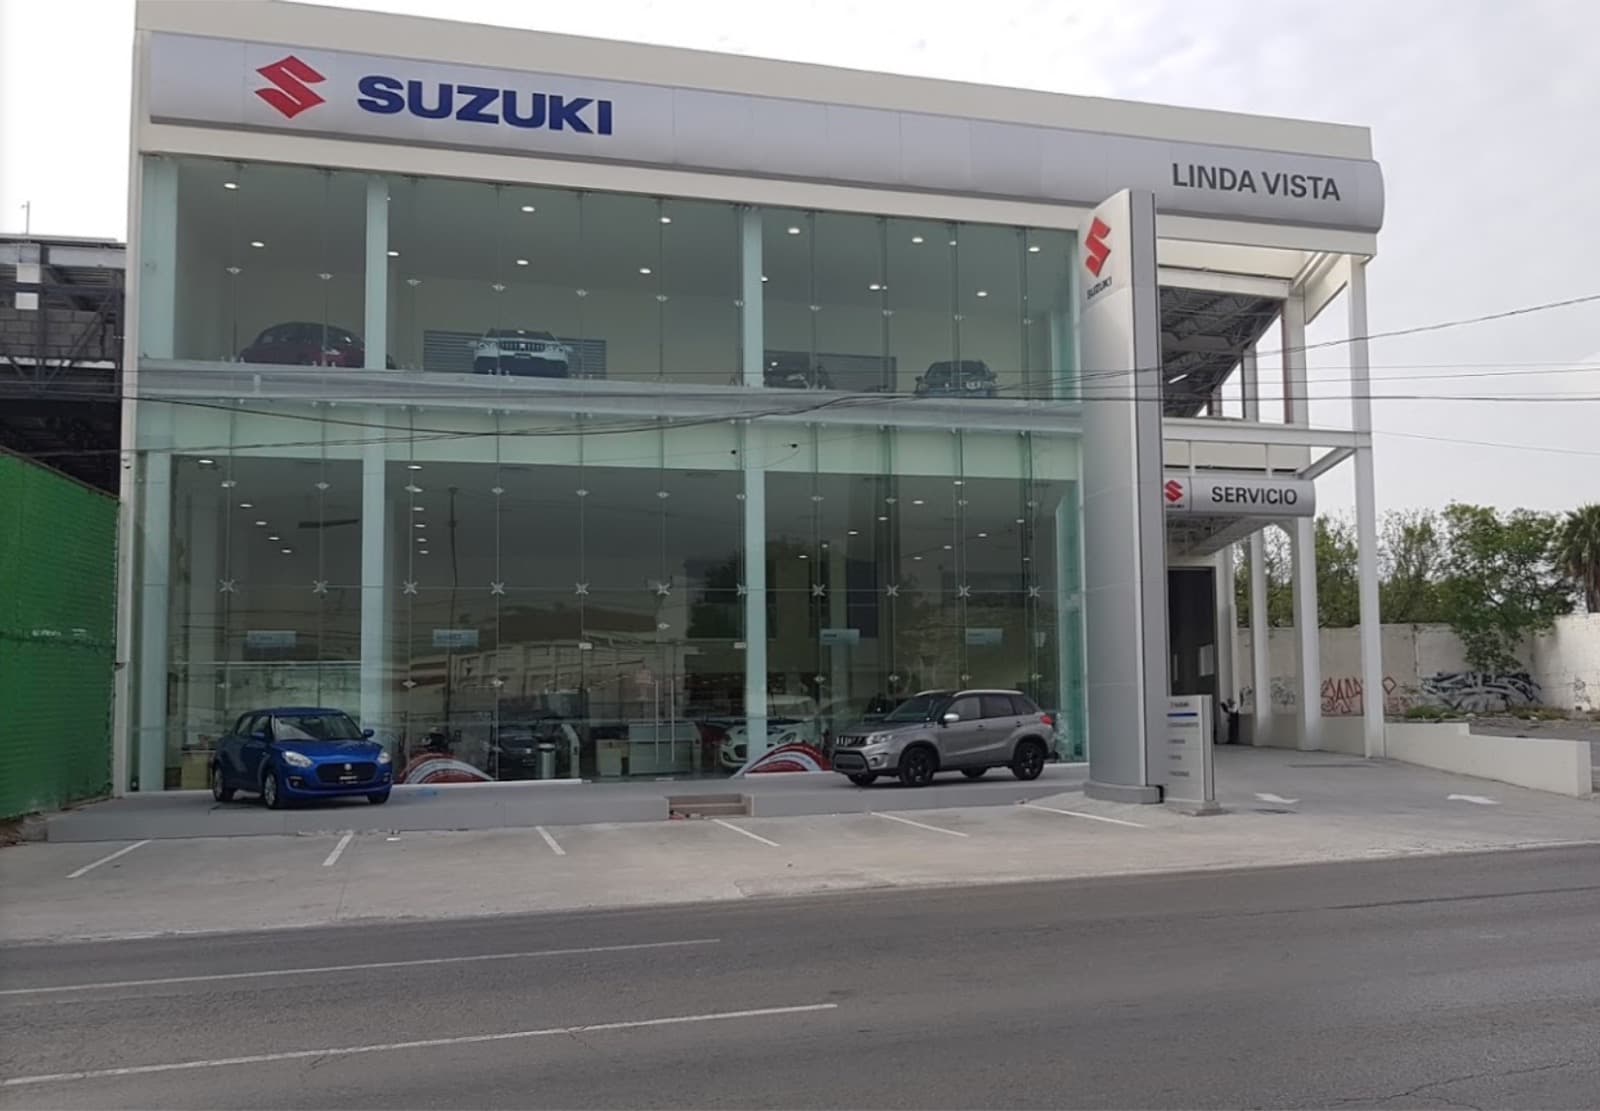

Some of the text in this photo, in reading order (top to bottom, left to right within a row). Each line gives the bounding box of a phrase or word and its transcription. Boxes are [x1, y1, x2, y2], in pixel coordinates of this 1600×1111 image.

[357, 75, 612, 136] SUZUKI
[1172, 163, 1341, 201] LINDA VISTA
[1211, 486, 1297, 505] SERVICIO
